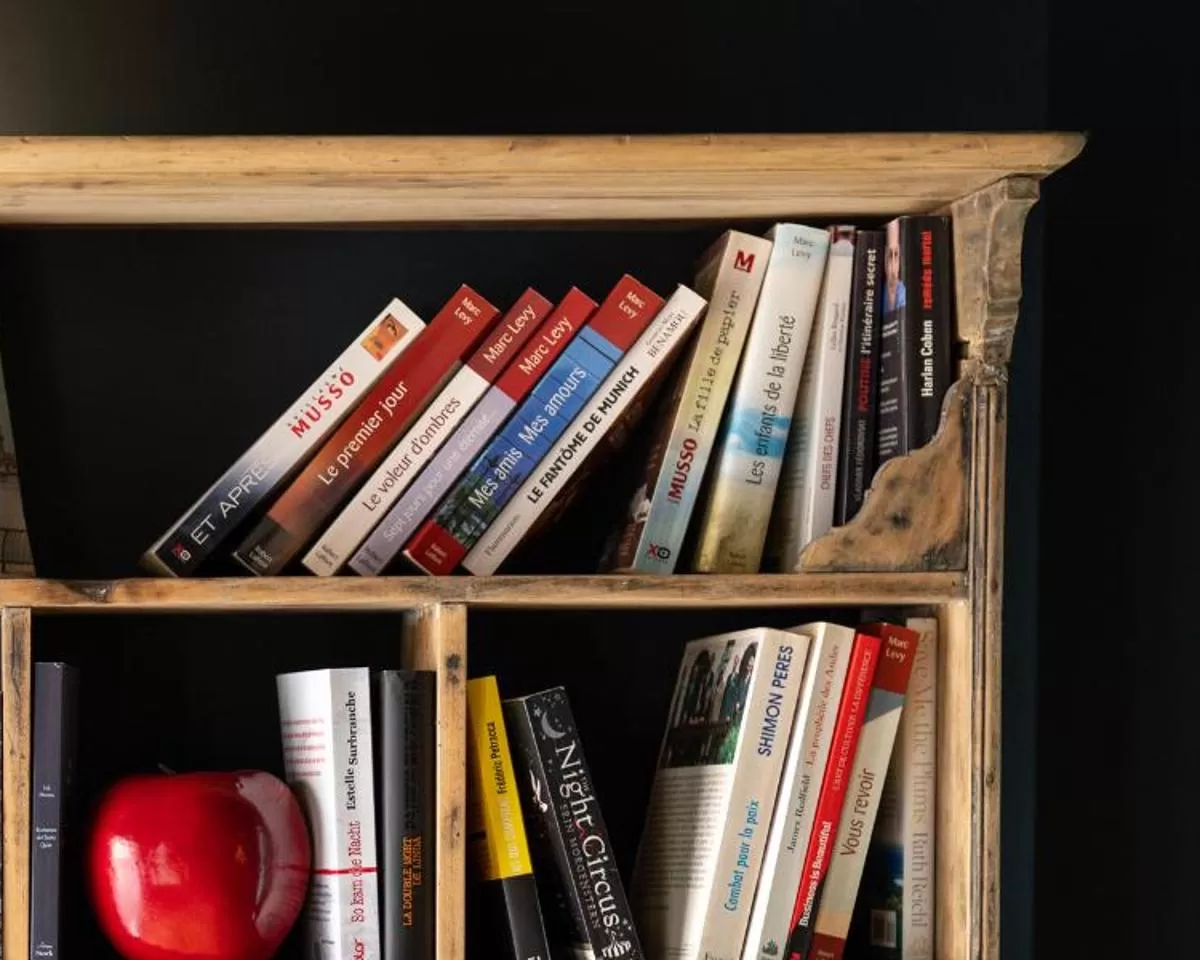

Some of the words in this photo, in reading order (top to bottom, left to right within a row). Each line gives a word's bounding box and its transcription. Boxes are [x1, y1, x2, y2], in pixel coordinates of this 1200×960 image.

[864, 247, 879, 287] secret
[483, 331, 512, 366] Marc
[507, 301, 539, 342] Levy
[518, 342, 547, 377] Marc
[542, 312, 573, 353] Levy
[771, 314, 798, 364] liberté
[859, 288, 877, 355] l'itinéraire
[919, 319, 935, 356] Coben
[671, 438, 699, 497] MUSSO
[709, 345, 724, 368] de
[717, 290, 743, 347] papier
[766, 381, 783, 402] de
[770, 363, 786, 381] la
[920, 357, 936, 397] Harlan
[291, 369, 356, 440] MUSSO
[320, 462, 340, 488] Le
[337, 407, 386, 472] premier
[378, 379, 410, 421] jour
[361, 491, 381, 512] Le
[376, 452, 414, 496] voleur
[409, 396, 463, 458] d'ombres
[467, 478, 500, 511] Mes
[496, 446, 525, 482] amis
[518, 415, 551, 448] Mes
[543, 364, 588, 418] amours
[527, 488, 545, 506] LE
[538, 432, 588, 489] FANTÔME
[582, 412, 603, 435] DE
[597, 365, 642, 418] MUNICH
[754, 406, 779, 459] enfants
[745, 460, 766, 487] Les
[190, 515, 219, 547] ET
[770, 643, 795, 689] PERES
[344, 690, 359, 765] Surbranche
[757, 690, 784, 757] SHIMON
[912, 721, 935, 754] the
[344, 767, 358, 810] Estelle
[742, 798, 761, 825] paix
[850, 766, 877, 814] revoir
[911, 760, 934, 824] Plums
[346, 820, 362, 856] Nacht
[553, 739, 595, 834] Night
[578, 833, 622, 930] Circus
[733, 840, 753, 868] pour
[738, 825, 753, 838] la
[810, 819, 835, 868] Beautiful
[839, 816, 866, 856] Vous
[911, 832, 932, 874] Ruth
[349, 879, 364, 905] kam
[724, 867, 748, 912] Combat
[808, 869, 822, 880] is
[351, 907, 365, 922] So
[798, 880, 819, 927] Business
[911, 875, 932, 929] Reichl
